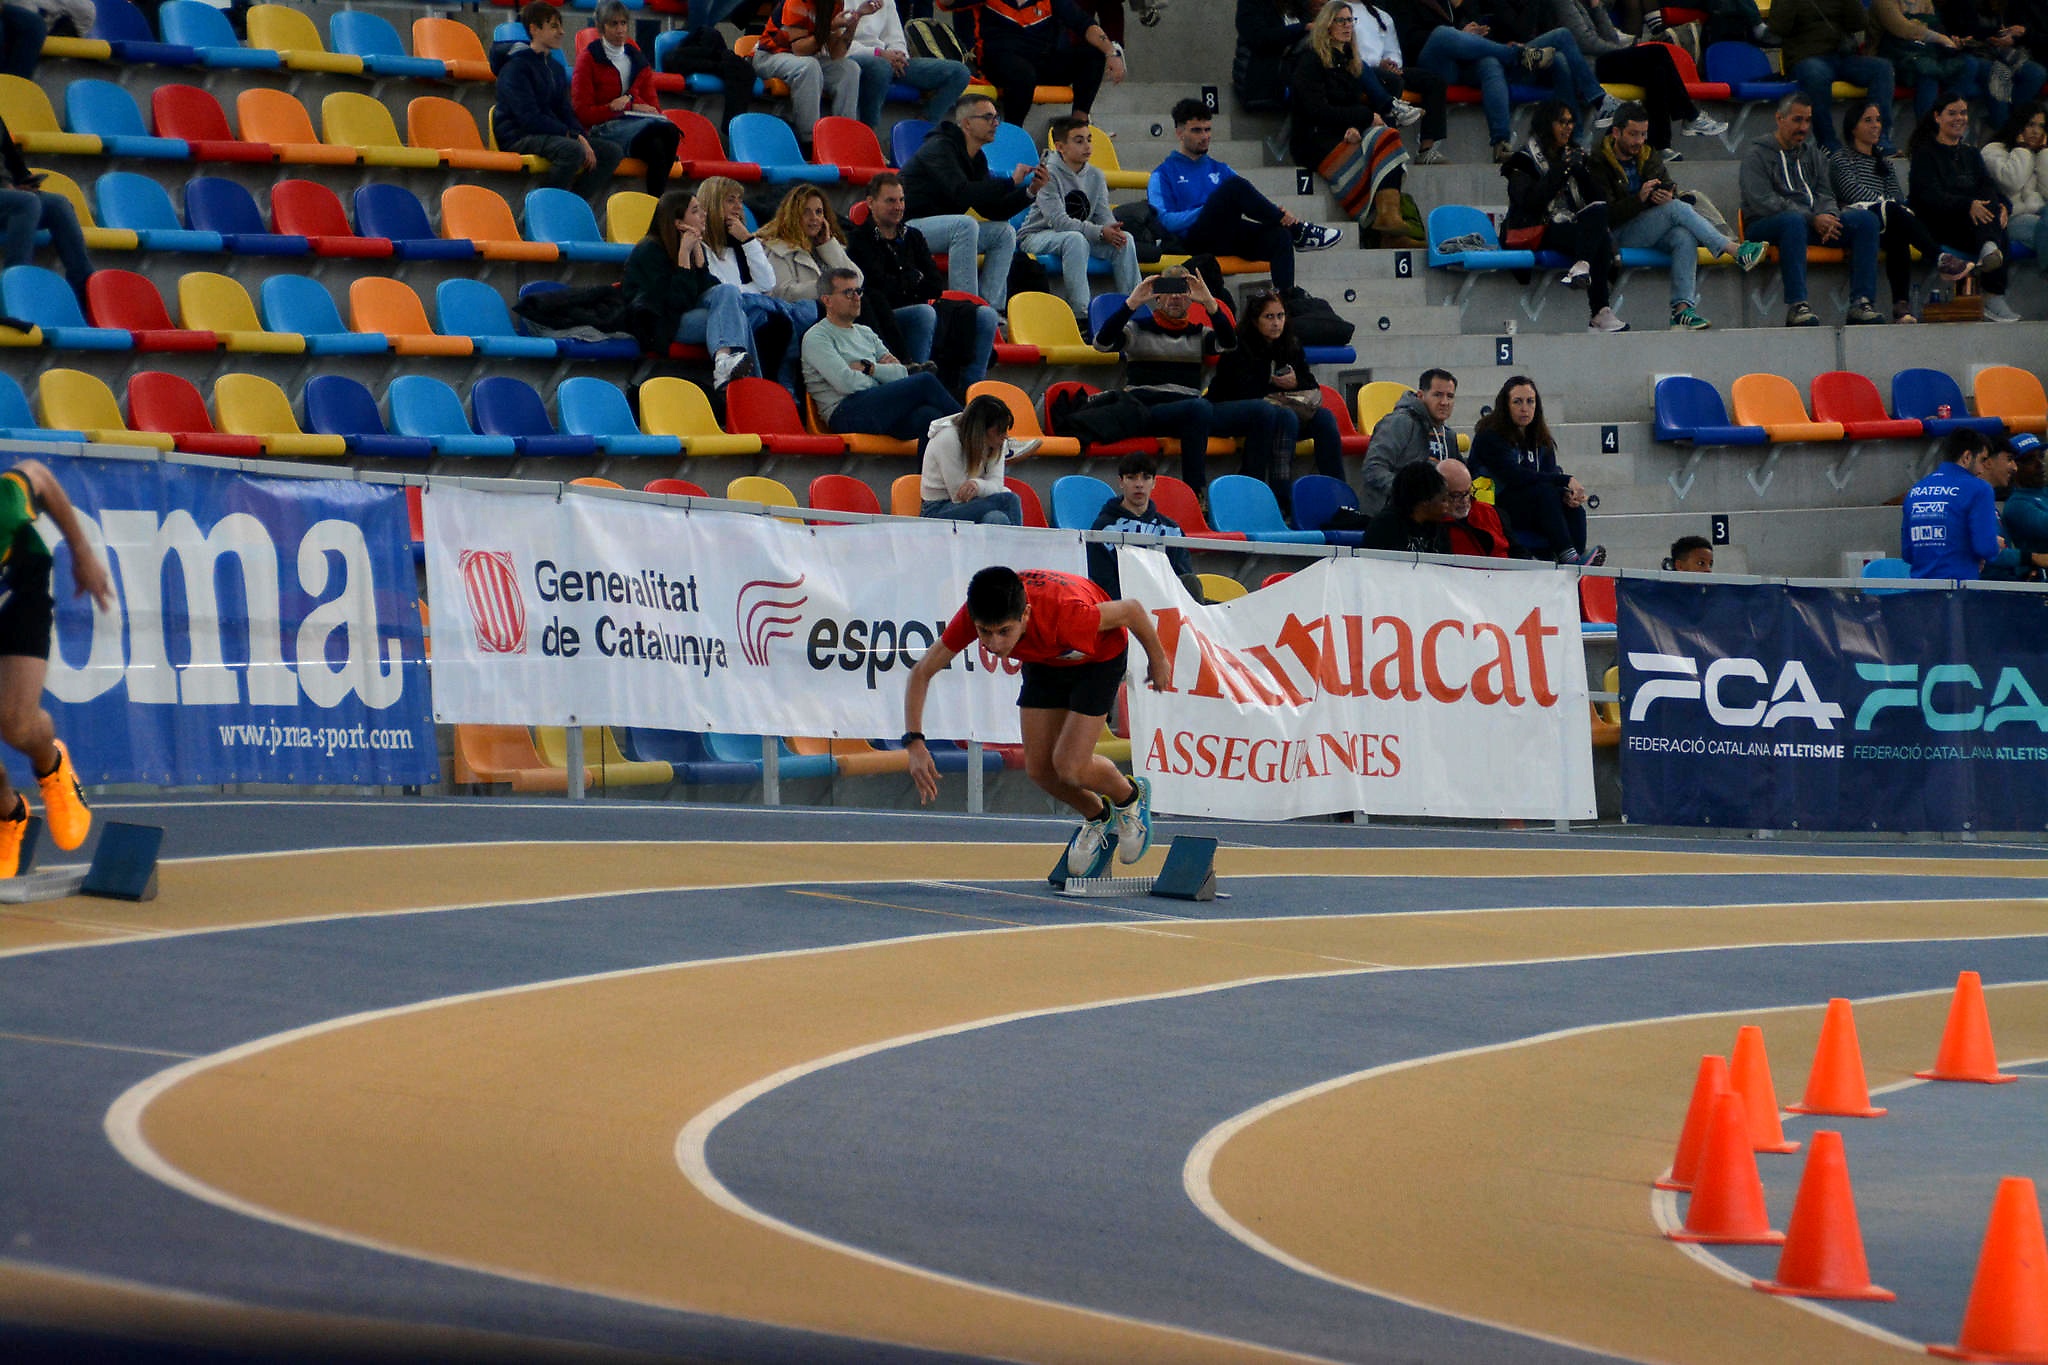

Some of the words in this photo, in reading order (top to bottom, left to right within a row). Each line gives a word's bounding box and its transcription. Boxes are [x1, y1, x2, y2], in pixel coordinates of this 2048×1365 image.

[1206, 92, 1215, 109] 8
[1300, 176, 1310, 193] 7
[1399, 258, 1409, 274] 6
[1500, 344, 1509, 360] 5
[1605, 432, 1616, 449] 4
[1715, 521, 1726, 539] 3
[534, 559, 700, 612] Generalitat
[36, 505, 403, 710] oma
[541, 616, 580, 658] de
[595, 615, 729, 677] Catalunya
[1628, 652, 1845, 730] FCA
[1855, 663, 2048, 734] FCA
[1628, 737, 1706, 755] FEDERACIÓ
[1708, 741, 1771, 756] CATALANA
[1773, 743, 1845, 759] ATLETISME
[1853, 742, 1922, 760] FEDERACIÓ
[1924, 745, 1993, 761] CATALANA
